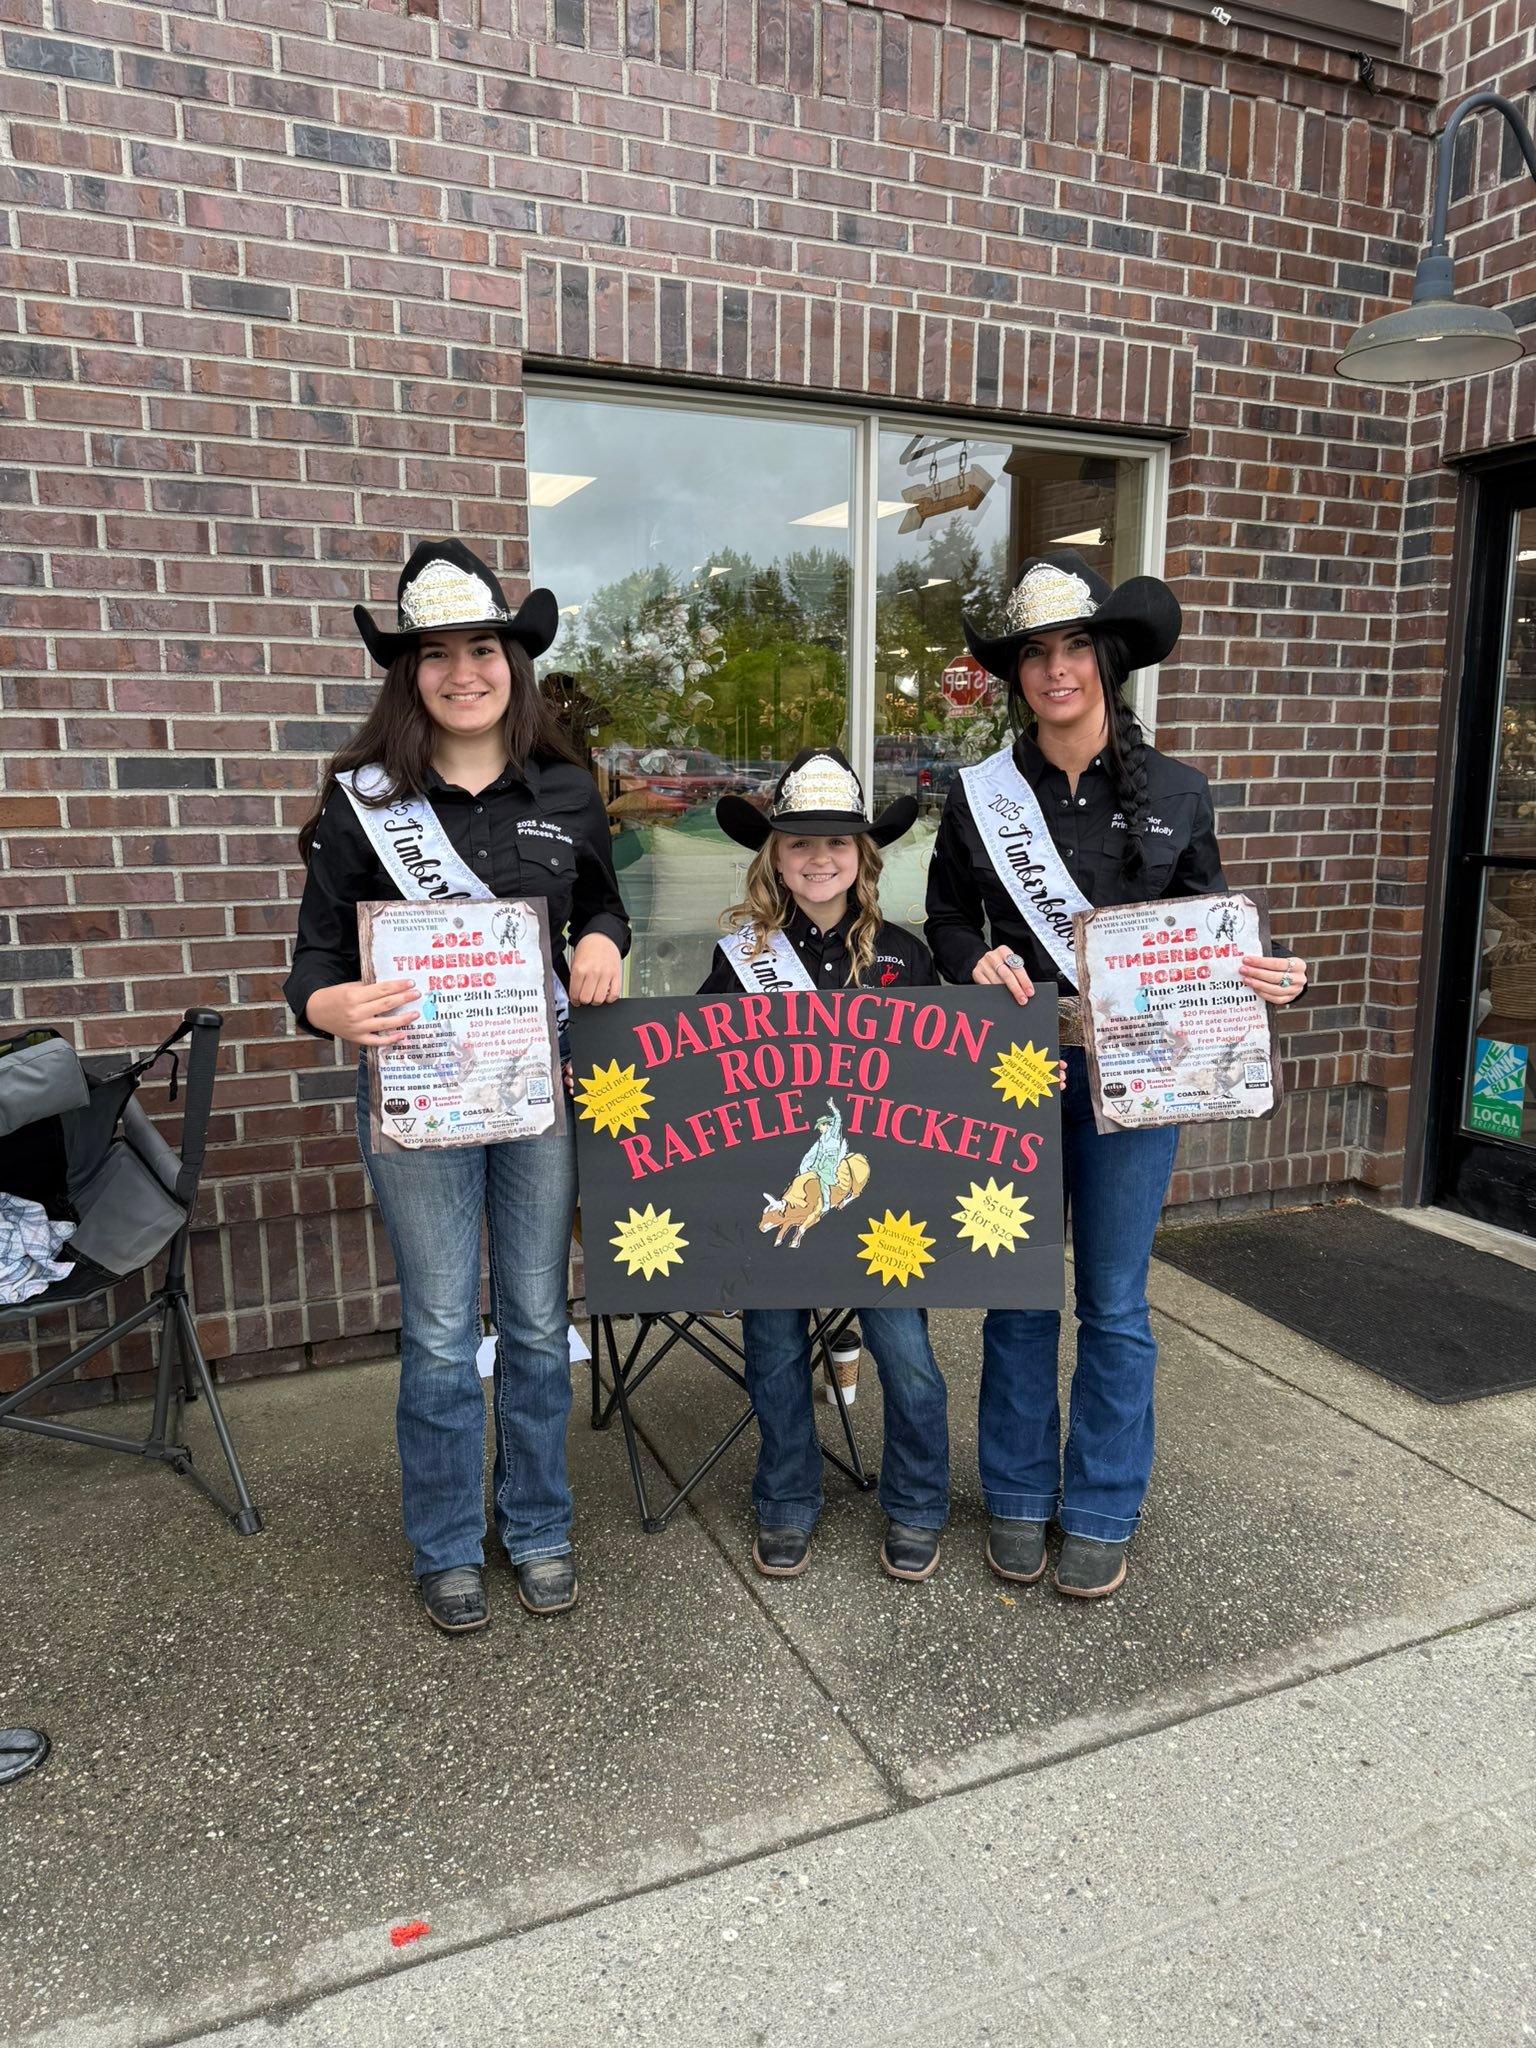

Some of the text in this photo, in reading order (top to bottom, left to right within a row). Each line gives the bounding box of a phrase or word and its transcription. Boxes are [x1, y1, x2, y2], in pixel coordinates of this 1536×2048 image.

[988, 794, 1024, 822] 2025
[516, 819, 562, 832] 2025 Junior
[517, 828, 554, 838] Princess
[1151, 825, 1174, 836] Molly
[1209, 902, 1240, 913] WSRRA
[431, 931, 484, 949] 2025
[1142, 927, 1198, 947] 2025
[393, 950, 527, 971] TIMBERBOWL
[876, 955, 906, 967] DHOA
[1105, 943, 1244, 970] TIMBERBOWL
[428, 972, 496, 991] RODEO
[1140, 966, 1211, 986] RODEO
[430, 988, 538, 1004] June 28th 5:30pm
[1142, 979, 1248, 998] June 28th 5:30p
[432, 1004, 538, 1021] June 29th 1:30pm
[1144, 994, 1257, 1012] June 29th 1:30pm
[1183, 1010, 1197, 1018] $20
[1199, 1008, 1228, 1016] Presale
[632, 991, 994, 1069] DARRINGTON
[1180, 1020, 1194, 1028] $30
[1205, 1017, 1222, 1027] gate
[1223, 1014, 1262, 1023] card/cash
[1224, 1025, 1246, 1033] under
[1248, 1023, 1265, 1031] Free
[490, 1029, 506, 1038] gate
[507, 1026, 543, 1035] card/cash
[716, 1043, 890, 1095] RODEO
[1022, 1057, 1039, 1072] PLACE
[1478, 1042, 1504, 1077] LIVE
[1484, 1046, 1526, 1085] THINK
[1009, 1074, 1025, 1089] PLACE
[1016, 1066, 1032, 1081] PLACE
[1490, 1068, 1525, 1095] BUY
[586, 1073, 630, 1102] Need not
[592, 1086, 639, 1116] be present
[463, 1108, 495, 1116] COASTAL
[609, 1105, 639, 1125] to win
[1472, 1106, 1520, 1129] LOCAL
[619, 1090, 1044, 1180] RAFFLE TICKETS
[983, 1195, 1014, 1218] $5 ea
[623, 1216, 659, 1239] 1st $300
[959, 1208, 1014, 1242] 5 for $20
[628, 1228, 669, 1253] 2nd $200
[876, 1224, 926, 1248] Drawing at
[637, 1242, 675, 1266] 3rd $100
[877, 1239, 916, 1259] Sunday's
[872, 1251, 914, 1272] RODEO
